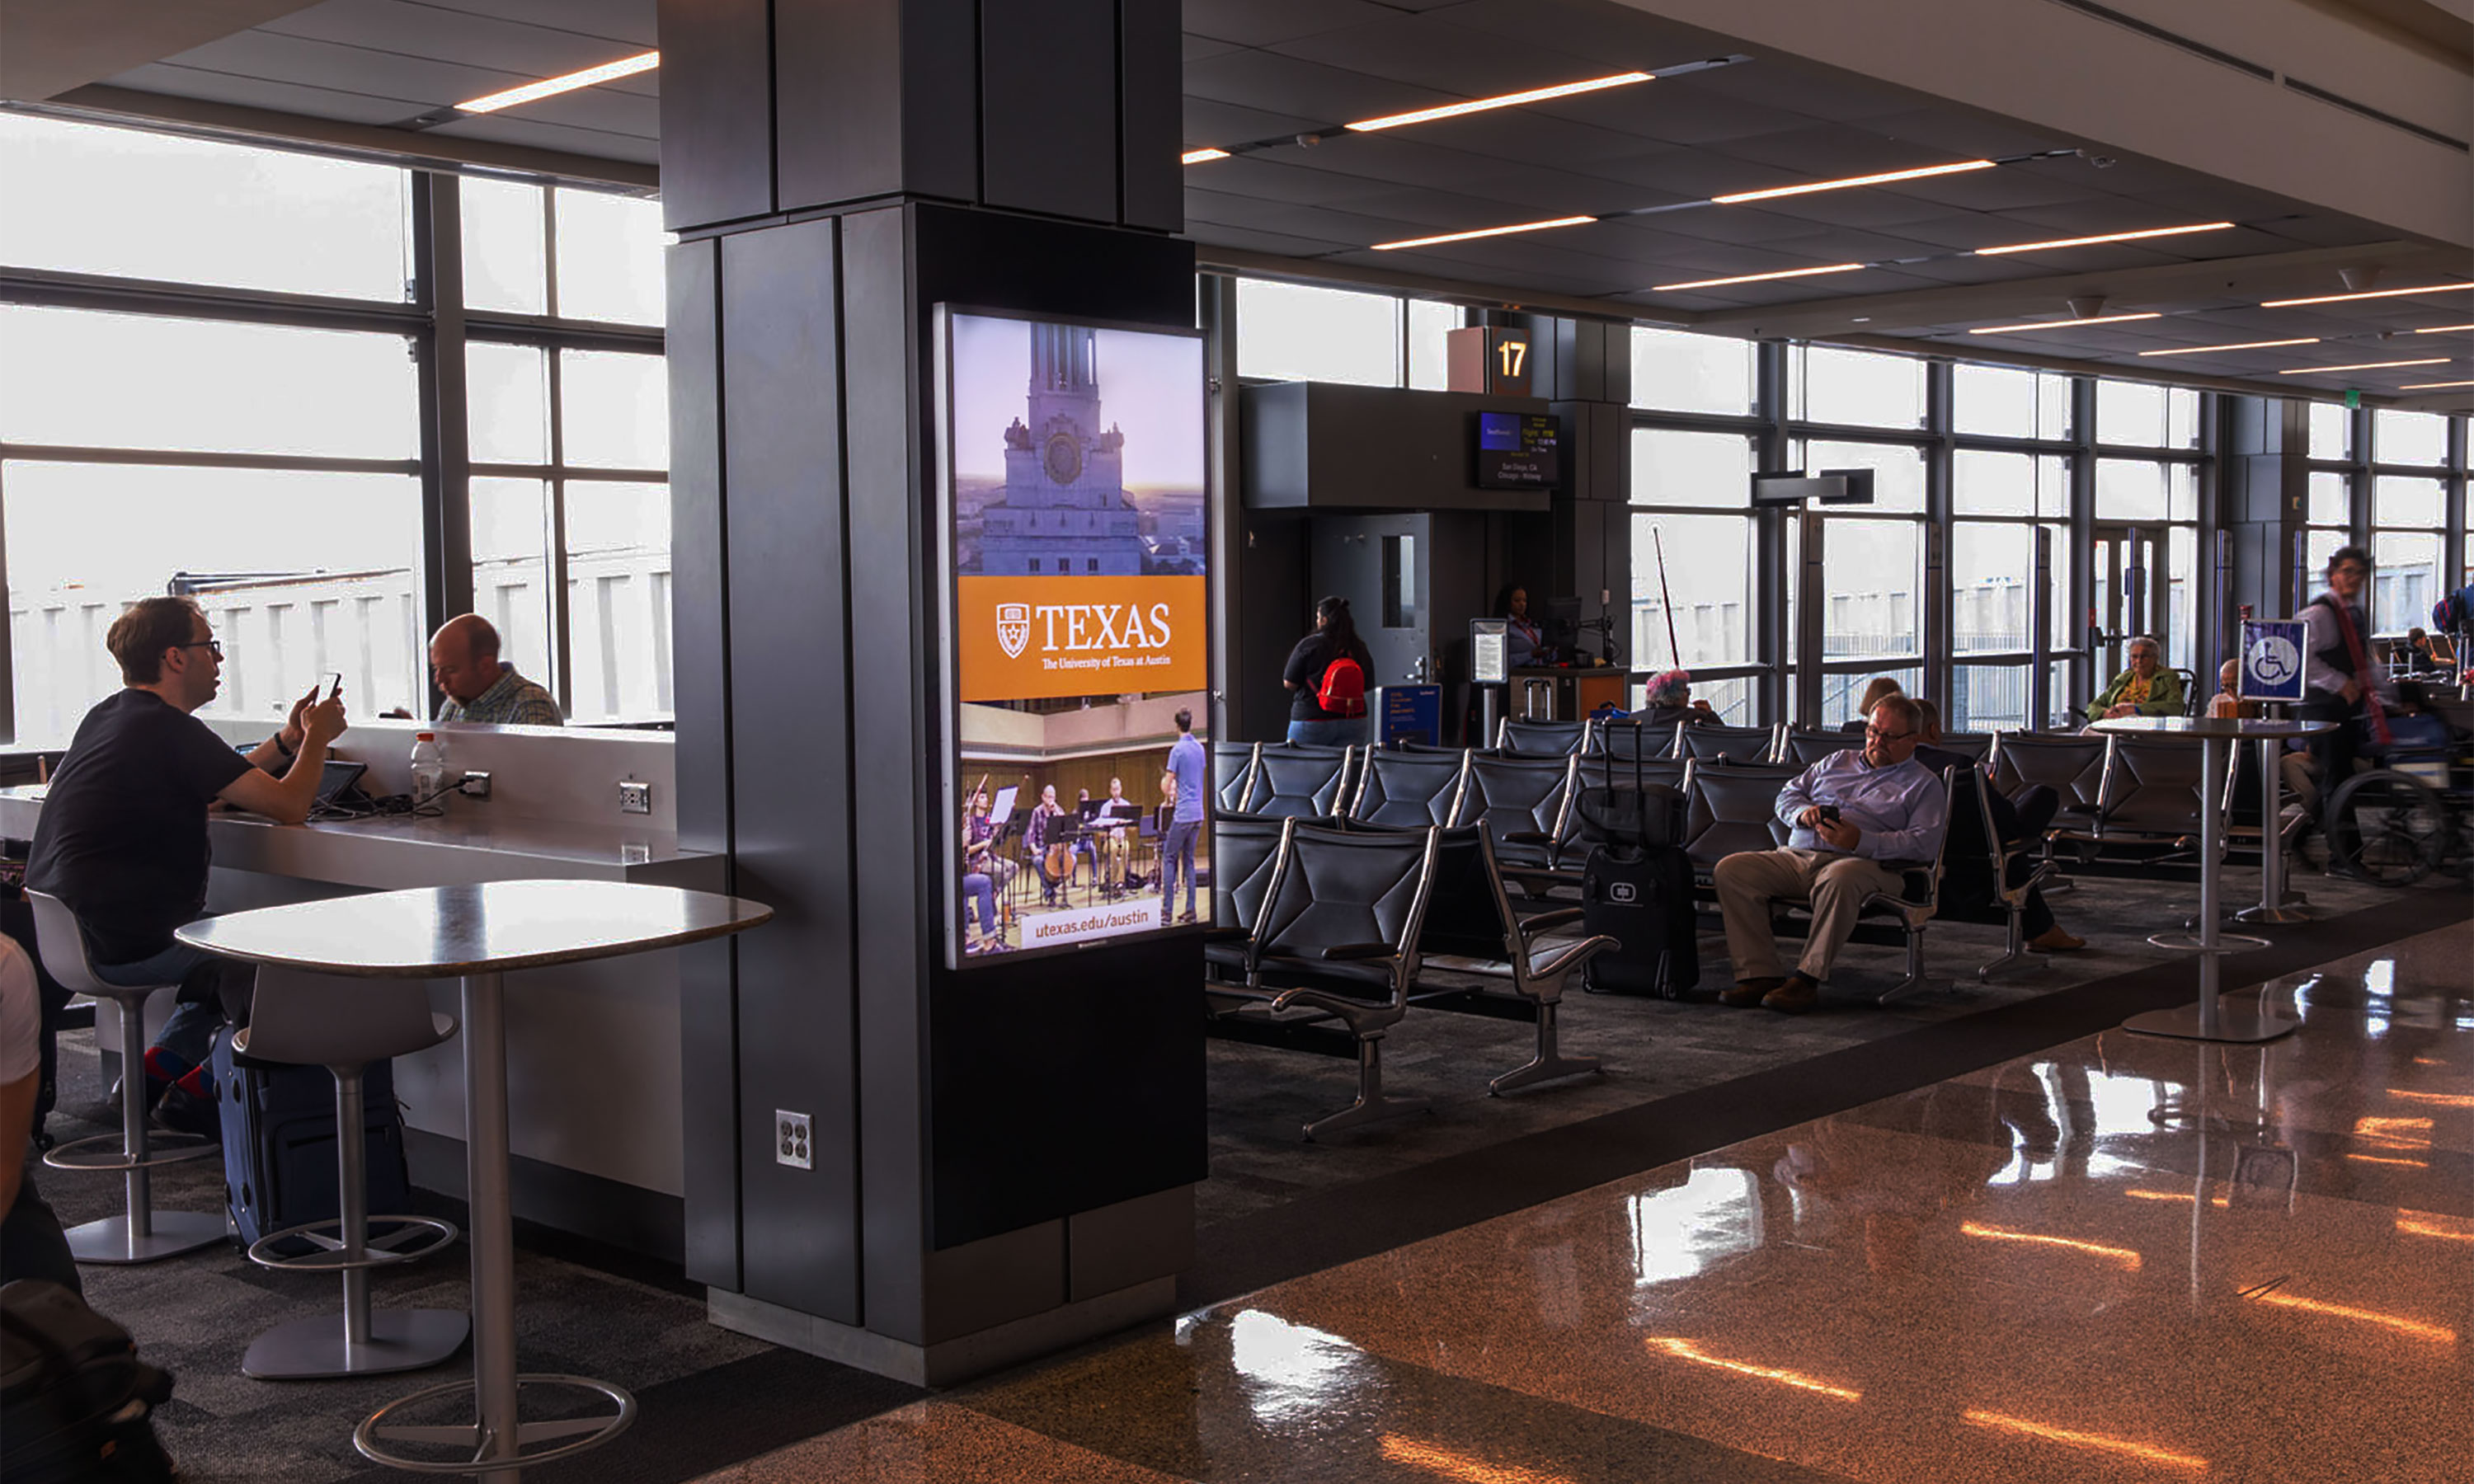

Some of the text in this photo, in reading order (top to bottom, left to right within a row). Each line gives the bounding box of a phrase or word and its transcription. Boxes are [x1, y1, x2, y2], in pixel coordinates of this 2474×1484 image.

[1498, 340, 1526, 377] 17
[1036, 603, 1171, 650] TEXAS
[1042, 655, 1171, 670] The University of Texas at Austin
[1036, 910, 1148, 937] utexas.edu/austin
